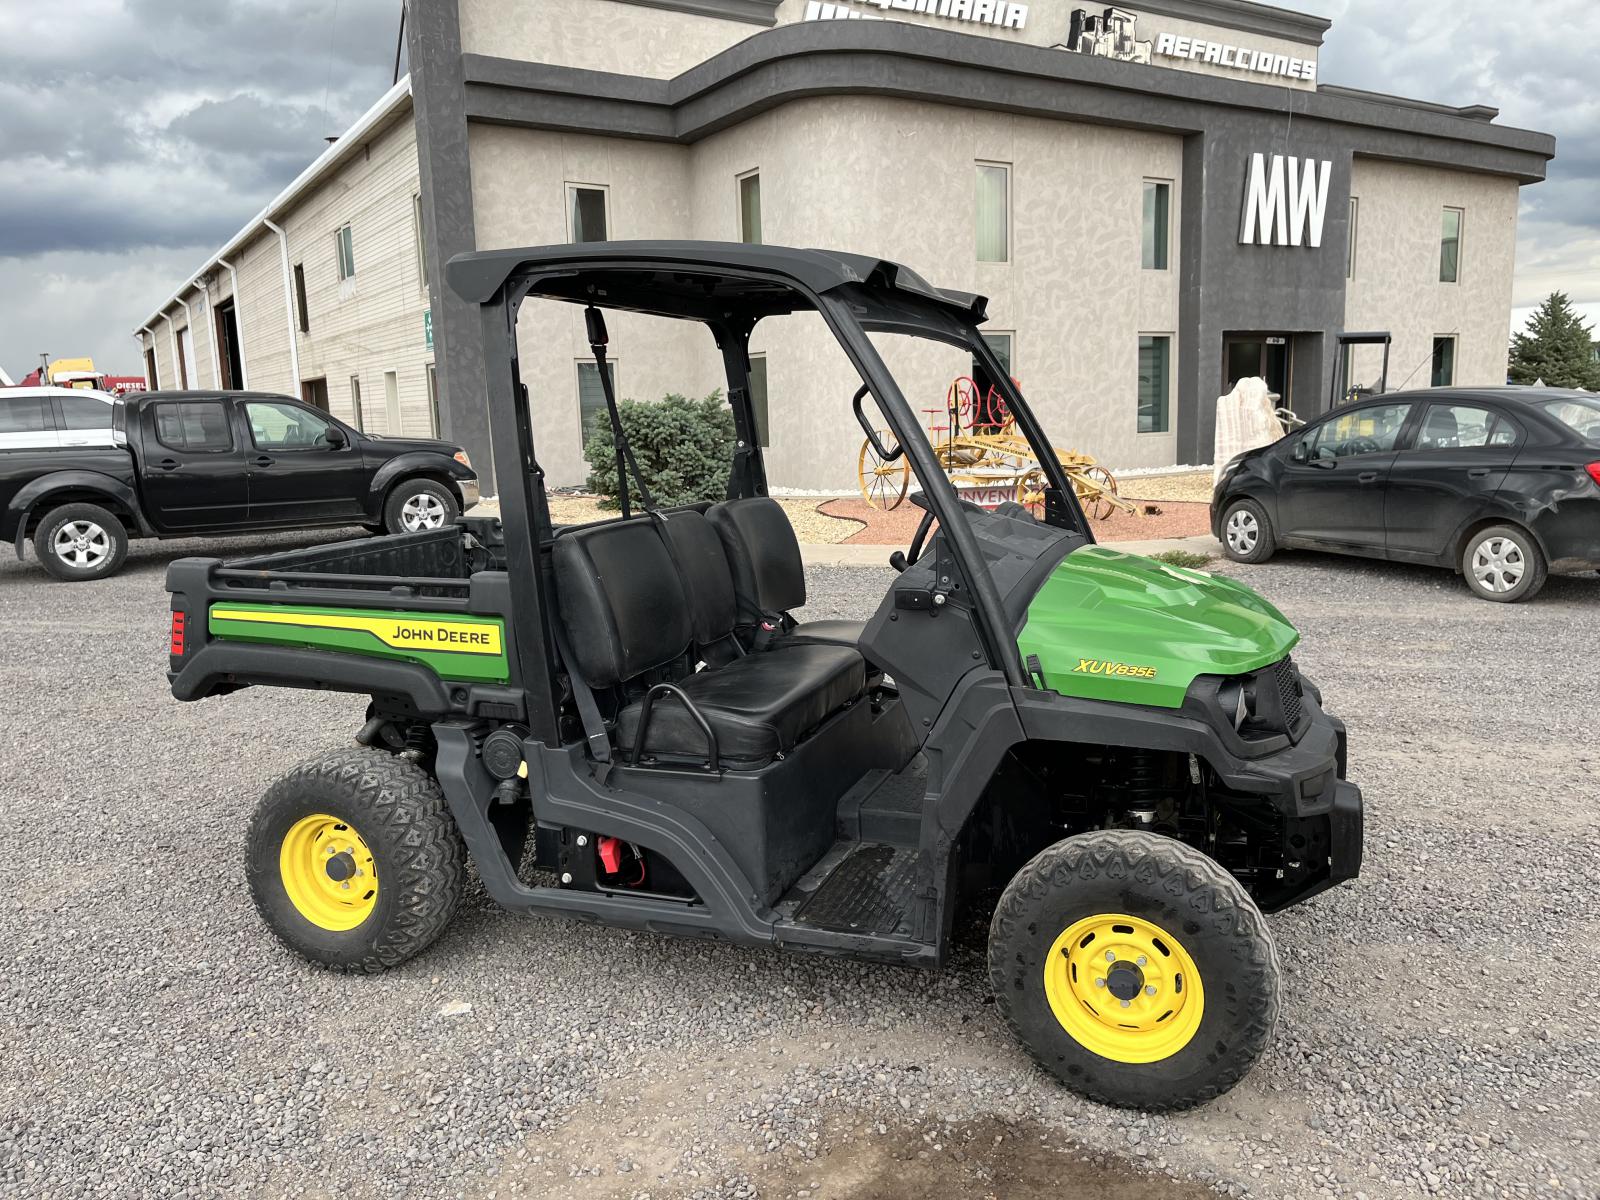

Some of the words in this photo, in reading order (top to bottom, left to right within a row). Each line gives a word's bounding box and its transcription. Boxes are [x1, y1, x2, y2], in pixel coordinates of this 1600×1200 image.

[1156, 32, 1318, 80] REFACCIONES
[1241, 152, 1332, 247] MW
[393, 626, 433, 640] JOHN
[438, 628, 490, 644] DEERE
[1072, 659, 1156, 679] XUV835E
